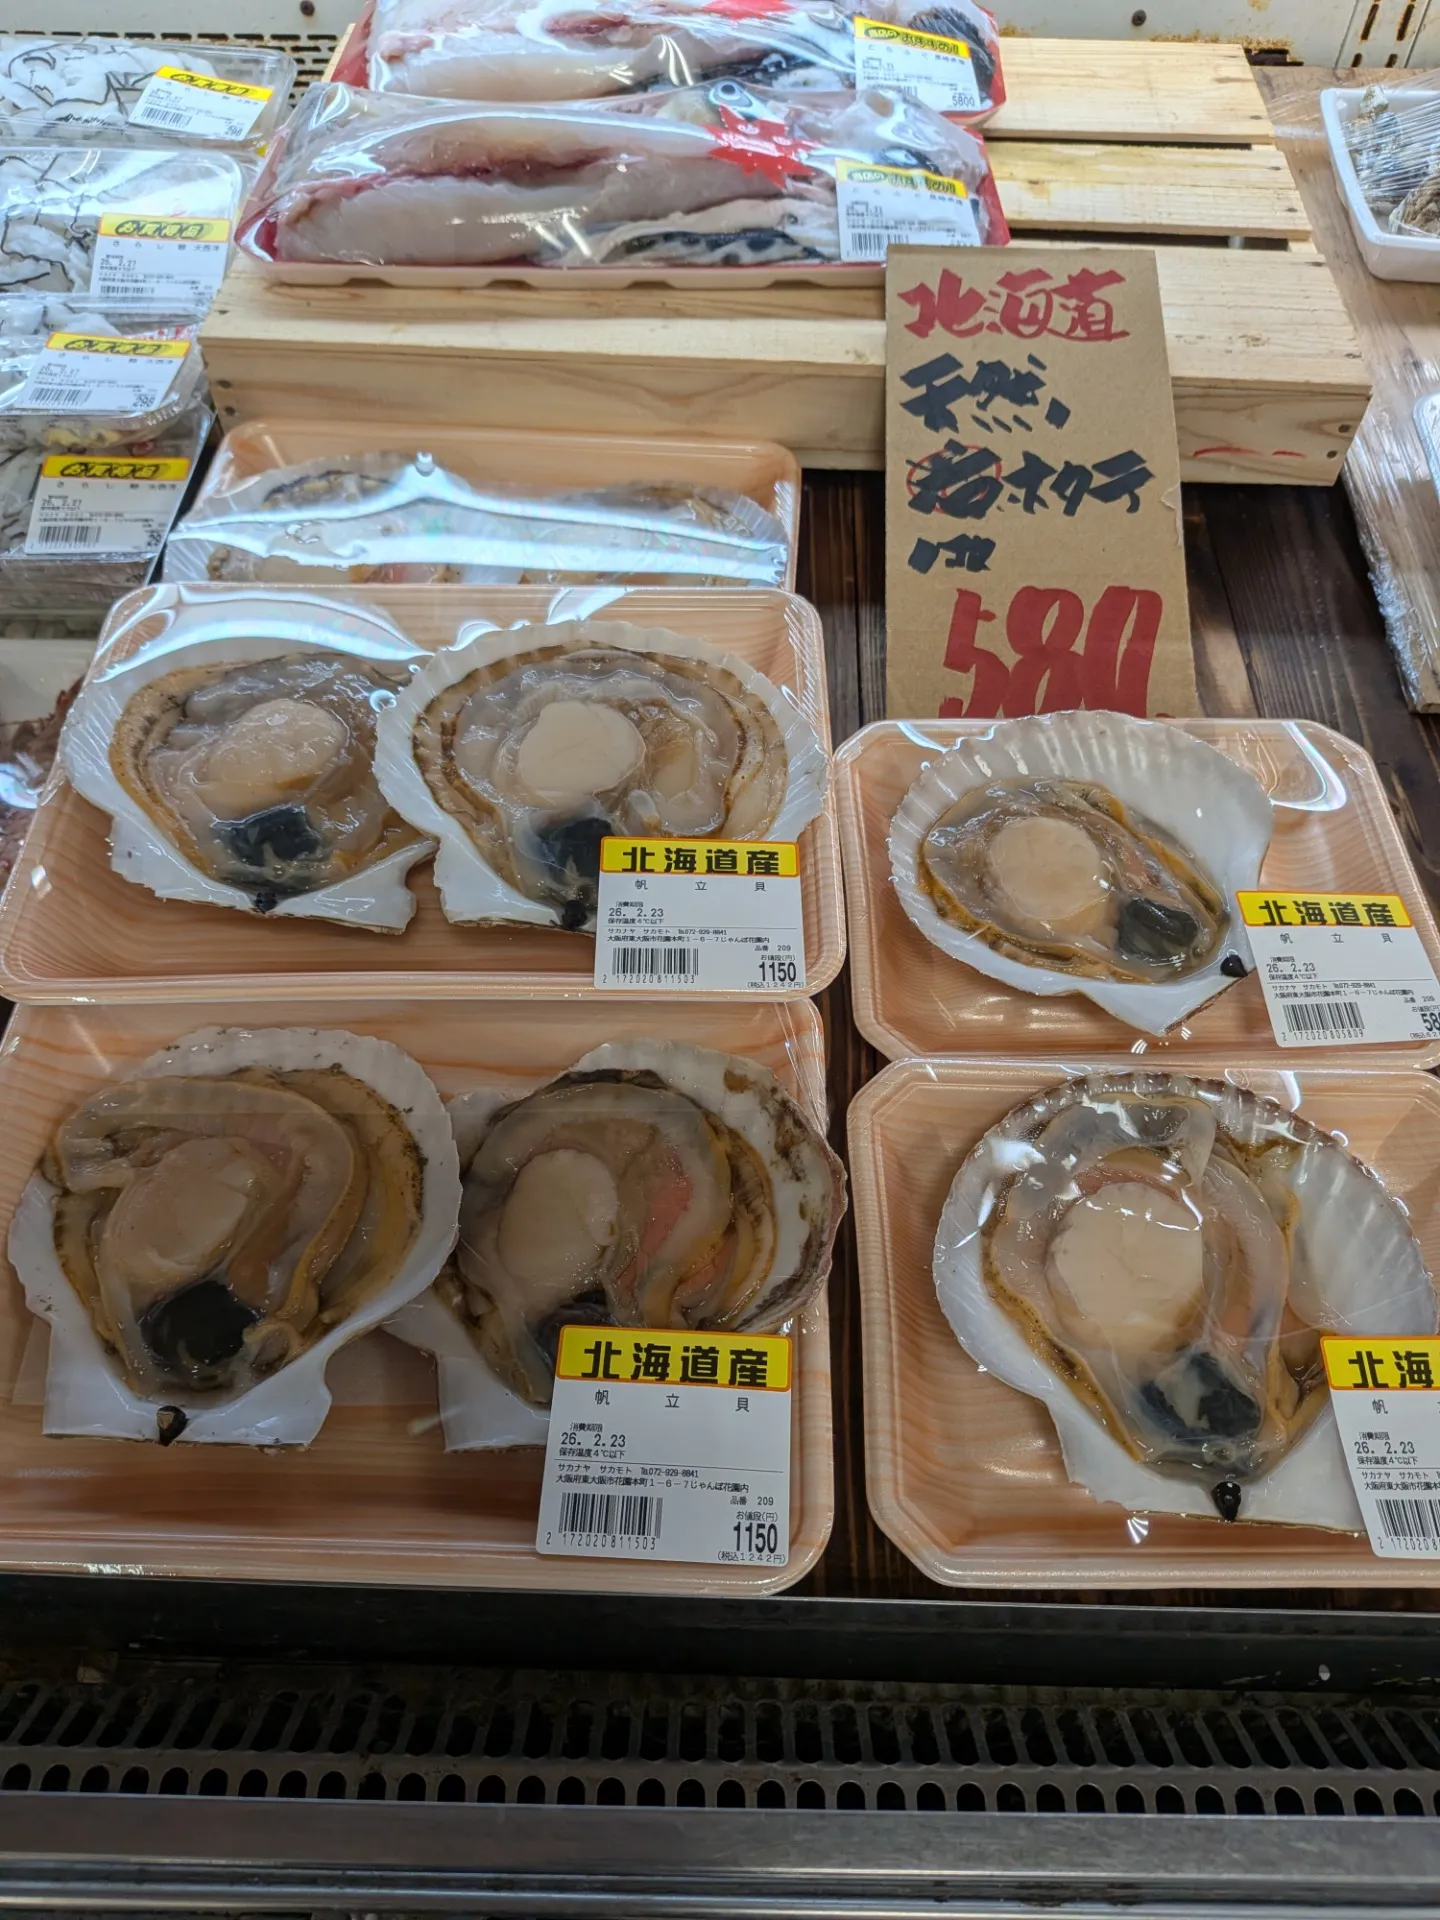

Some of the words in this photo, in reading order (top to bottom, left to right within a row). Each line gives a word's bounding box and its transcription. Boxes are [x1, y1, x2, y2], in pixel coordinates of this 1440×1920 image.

[897, 267, 1130, 342] 北海道
[147, 534, 163, 546] 29
[938, 585, 1163, 718] 580
[622, 846, 779, 875] 北海道産
[608, 907, 626, 917] 26.
[636, 908, 664, 917] 2.23
[1259, 900, 1397, 927] 北海道産
[758, 961, 797, 982] 1150
[1266, 963, 1284, 973] 26.
[1290, 963, 1316, 973] 2.23
[581, 1340, 768, 1387] 北海道産
[1348, 1350, 1440, 1388] 北海
[569, 1422, 603, 1432] 消費期限
[560, 1431, 582, 1446] 26.
[593, 1433, 626, 1448] 2.23
[1354, 1441, 1375, 1455] 26.
[1384, 1441, 1415, 1455] 2.23
[558, 1464, 591, 1473] サカナヤ
[599, 1465, 632, 1474] サカモト
[1361, 1471, 1391, 1480] サカナヤ
[1398, 1471, 1429, 1480] サカモト
[729, 1495, 747, 1506] 品番
[757, 1496, 774, 1506] 209
[733, 1521, 778, 1554] 1150
